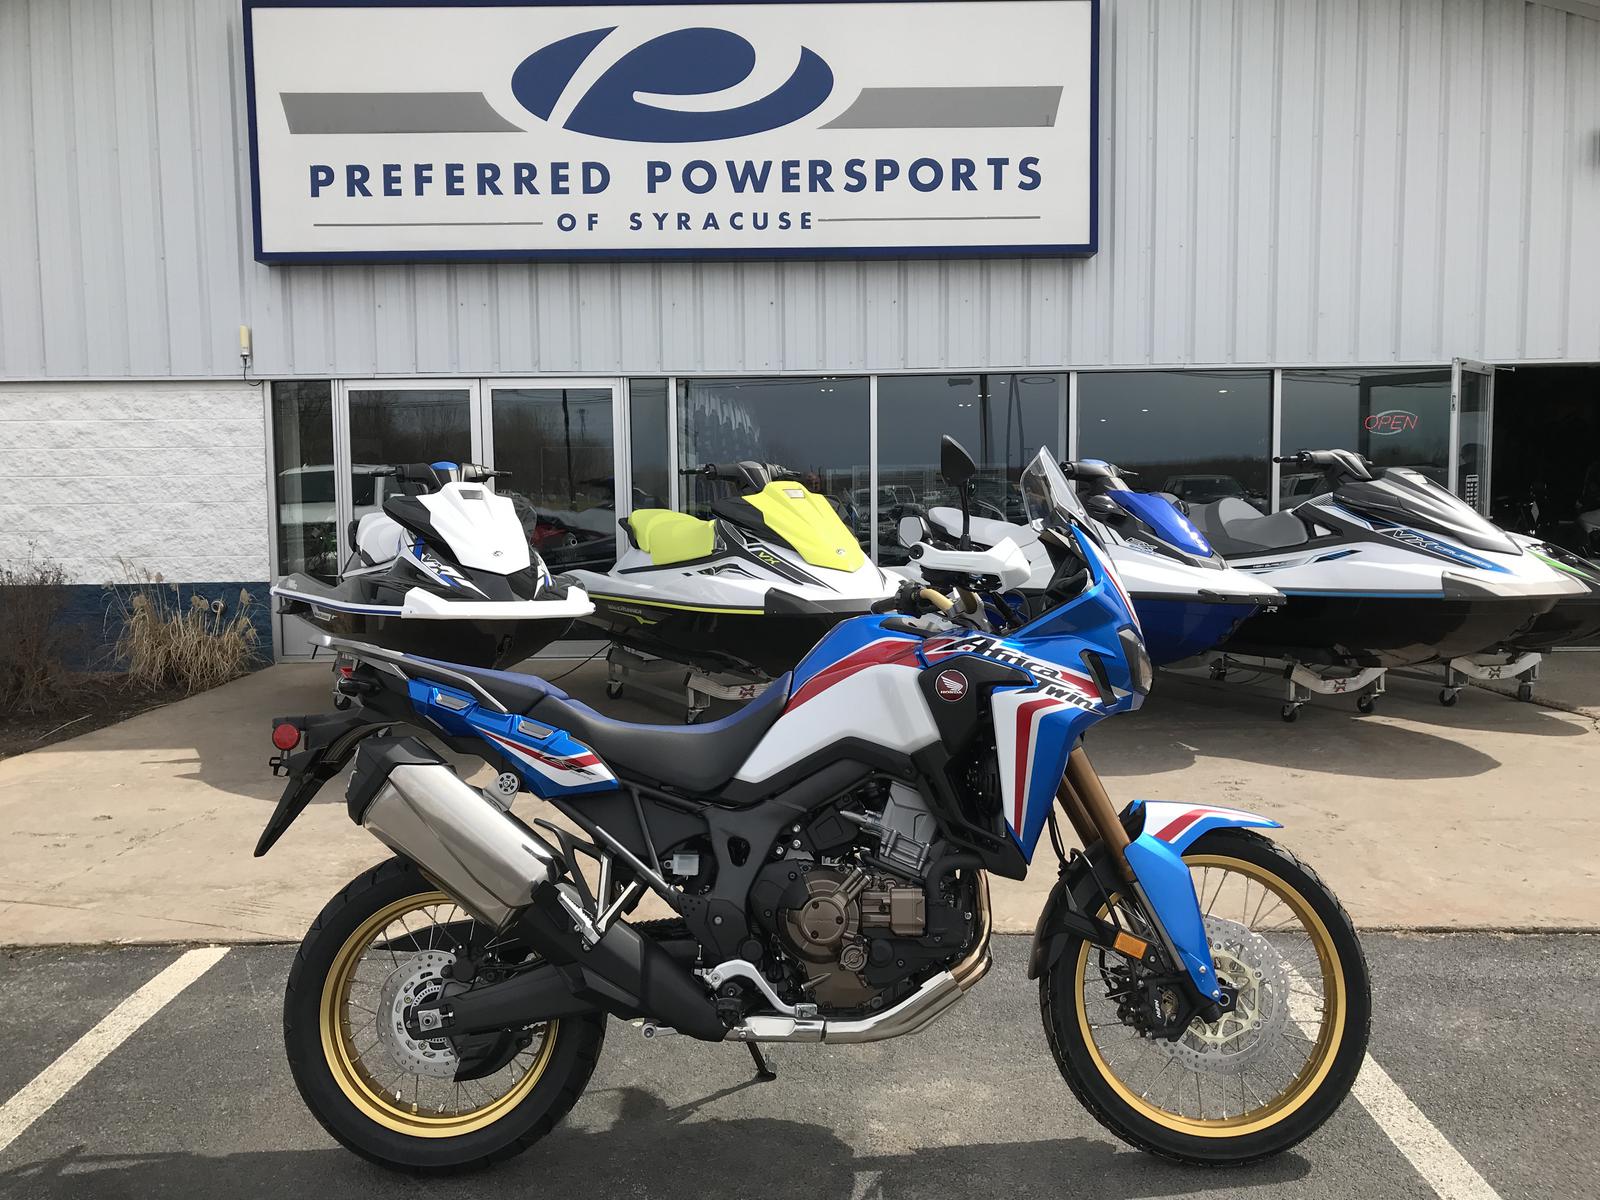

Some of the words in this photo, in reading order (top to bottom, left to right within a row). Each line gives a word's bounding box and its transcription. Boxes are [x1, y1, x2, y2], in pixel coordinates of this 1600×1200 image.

[309, 161, 611, 198] PREFERRED
[646, 157, 1042, 194] POWERSPORTS
[556, 213, 599, 232] OF
[628, 211, 812, 231] SYRACUSE
[1364, 415, 1419, 430] OPEN
[1393, 528, 1438, 548] VX
[758, 551, 780, 565] VX
[932, 636, 1061, 679] Africa
[1014, 678, 1106, 716] Twin
